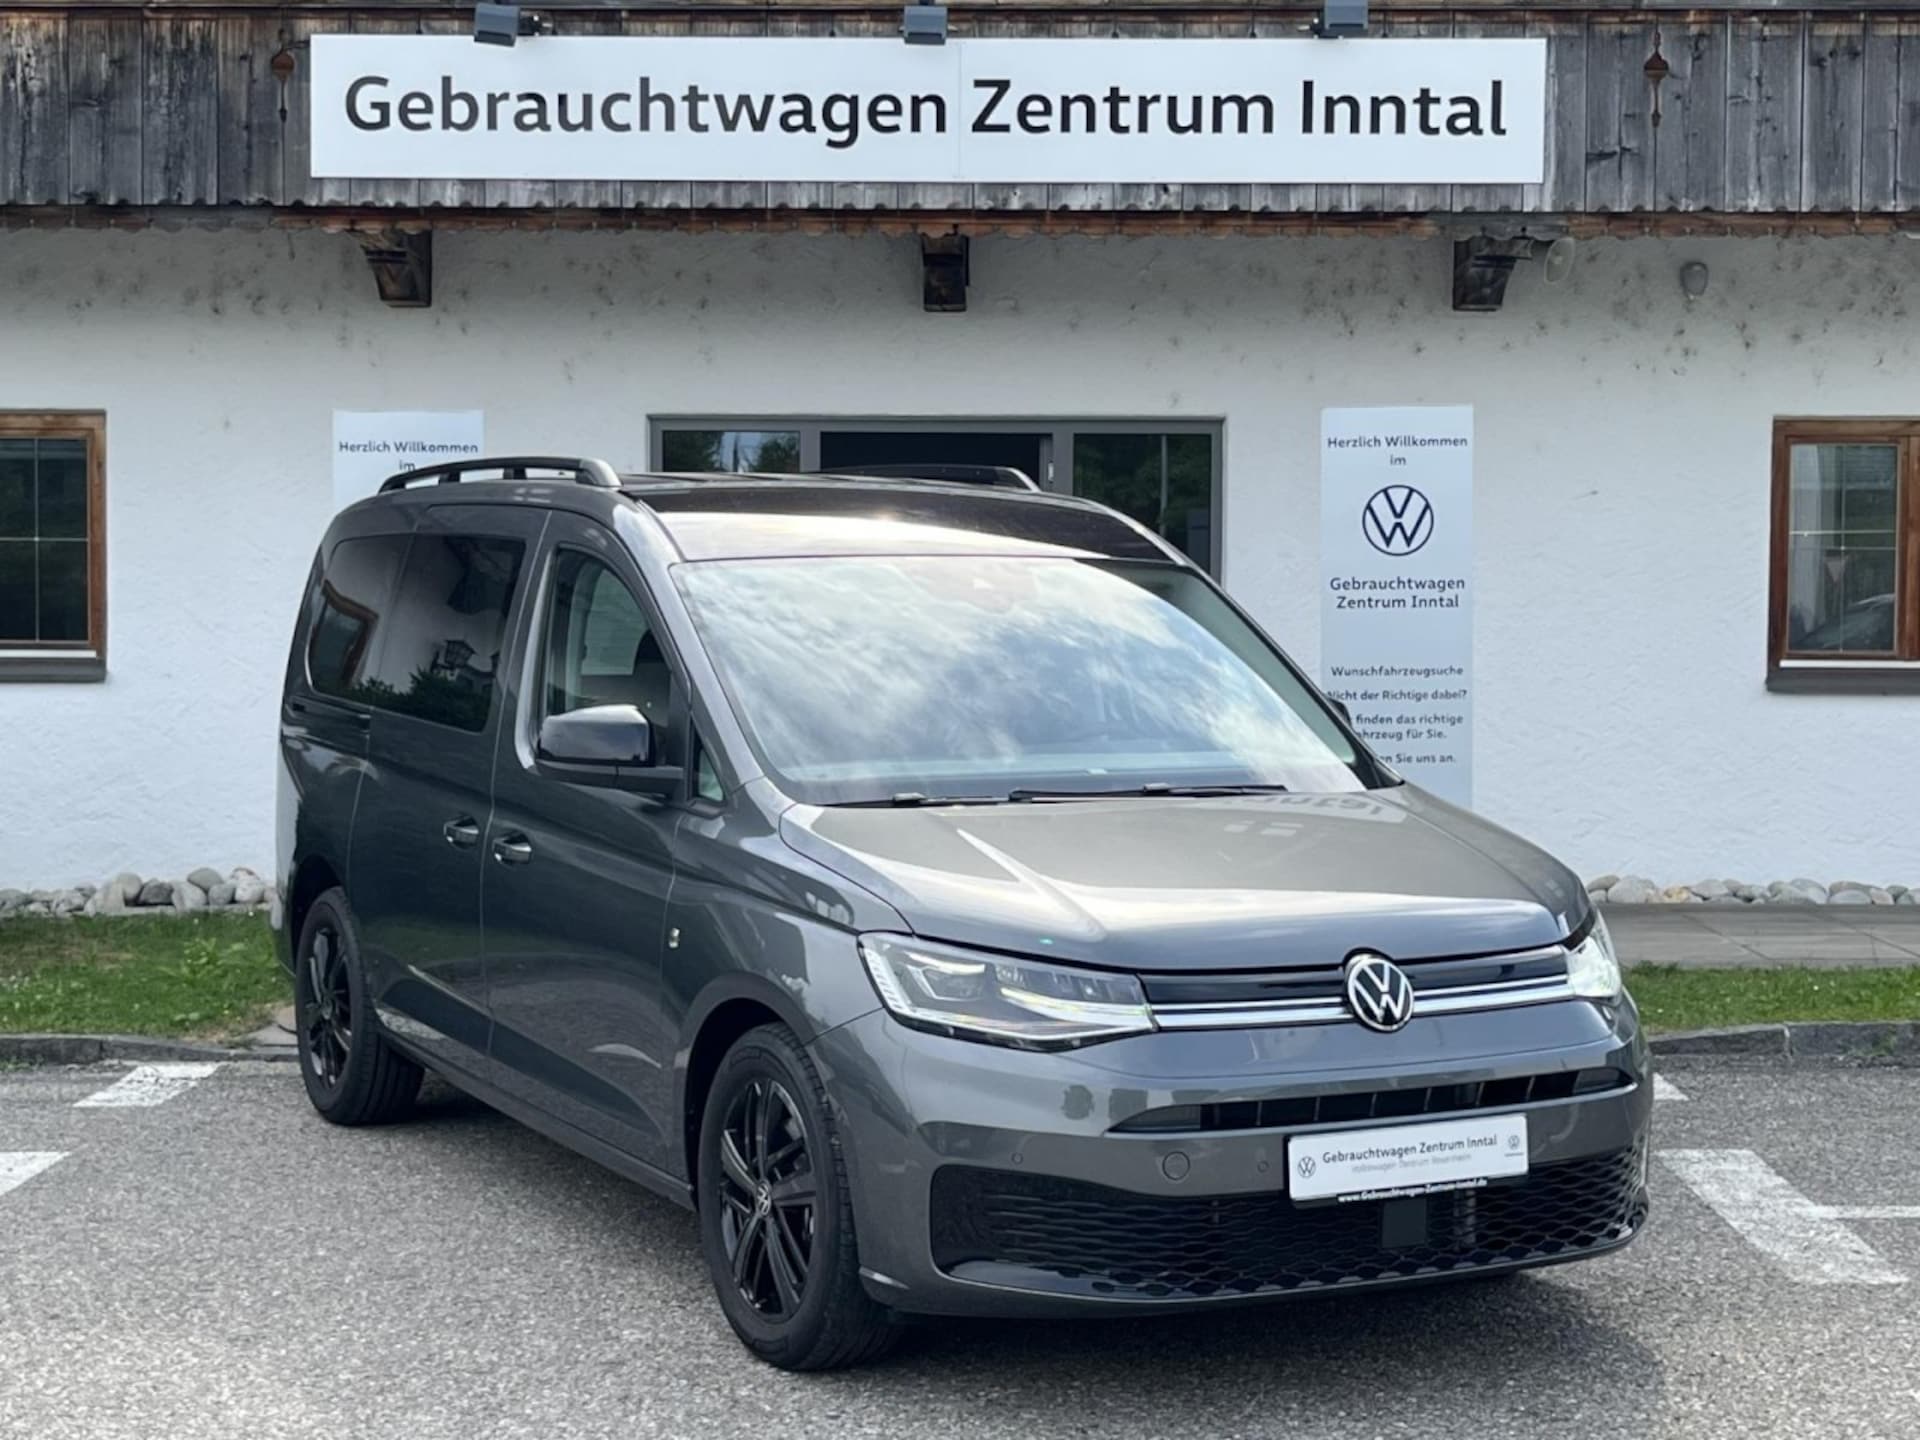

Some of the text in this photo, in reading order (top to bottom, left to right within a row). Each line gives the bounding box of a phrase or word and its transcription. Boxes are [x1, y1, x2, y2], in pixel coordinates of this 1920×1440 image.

[344, 75, 1507, 148] Gebrauchtwagen Zentrum Inntal
[339, 440, 479, 453] Herzlich Willkommen
[1327, 436, 1468, 448] Herzlich Willkommen
[399, 460, 415, 471] im
[1390, 455, 1406, 466] im
[1363, 485, 1433, 556] VW
[1330, 576, 1465, 593] Gebrauchtwagen
[1336, 595, 1459, 609] Zentrum Inntal
[1331, 666, 1463, 678] Wunschfahrzeugsuche
[1360, 690, 1379, 700] der
[1382, 690, 1428, 702] Richtige
[1431, 689, 1468, 699] dabei?
[1356, 714, 1392, 724] finden
[1396, 714, 1416, 724] das
[1419, 714, 1463, 726] richtige
[1406, 729, 1424, 739] für
[1427, 729, 1447, 739] Sie.
[1396, 753, 1412, 763] Sie
[1416, 755, 1436, 763] uns
[1348, 957, 1414, 1031] VW
[1322, 1134, 1498, 1164] Gebrauchtwagen Zentrum Inntal
